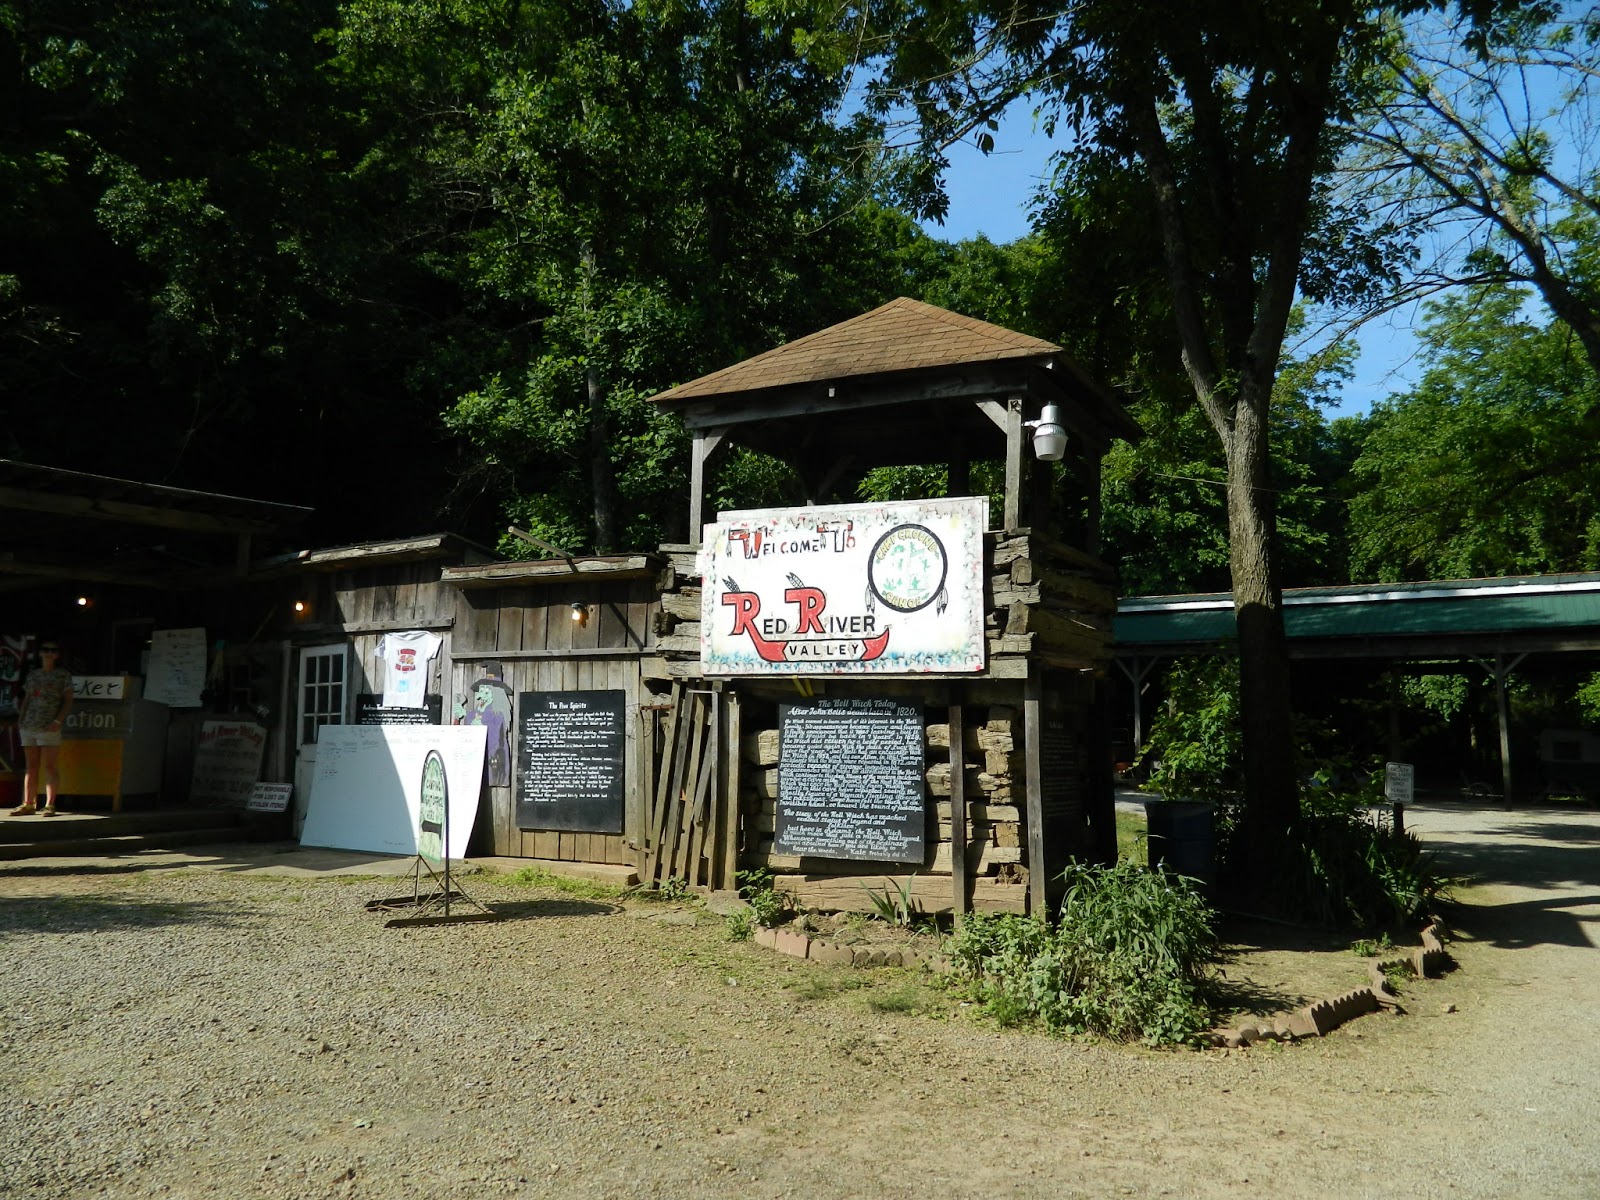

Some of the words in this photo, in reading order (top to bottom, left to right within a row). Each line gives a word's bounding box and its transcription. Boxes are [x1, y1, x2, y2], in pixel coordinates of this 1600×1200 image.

[729, 527, 819, 559] WELCOME
[817, 520, 856, 553] TO
[898, 529, 937, 553] GROUND
[722, 591, 788, 637] RED
[785, 587, 876, 635] RIVER
[789, 644, 859, 656] VALLEY
[570, 702, 586, 711] Spirits
[833, 699, 849, 707] Bell
[852, 699, 872, 707] Witch
[874, 699, 896, 709] Today
[787, 706, 809, 716] After
[809, 707, 827, 716] John
[897, 707, 917, 716] 1820.
